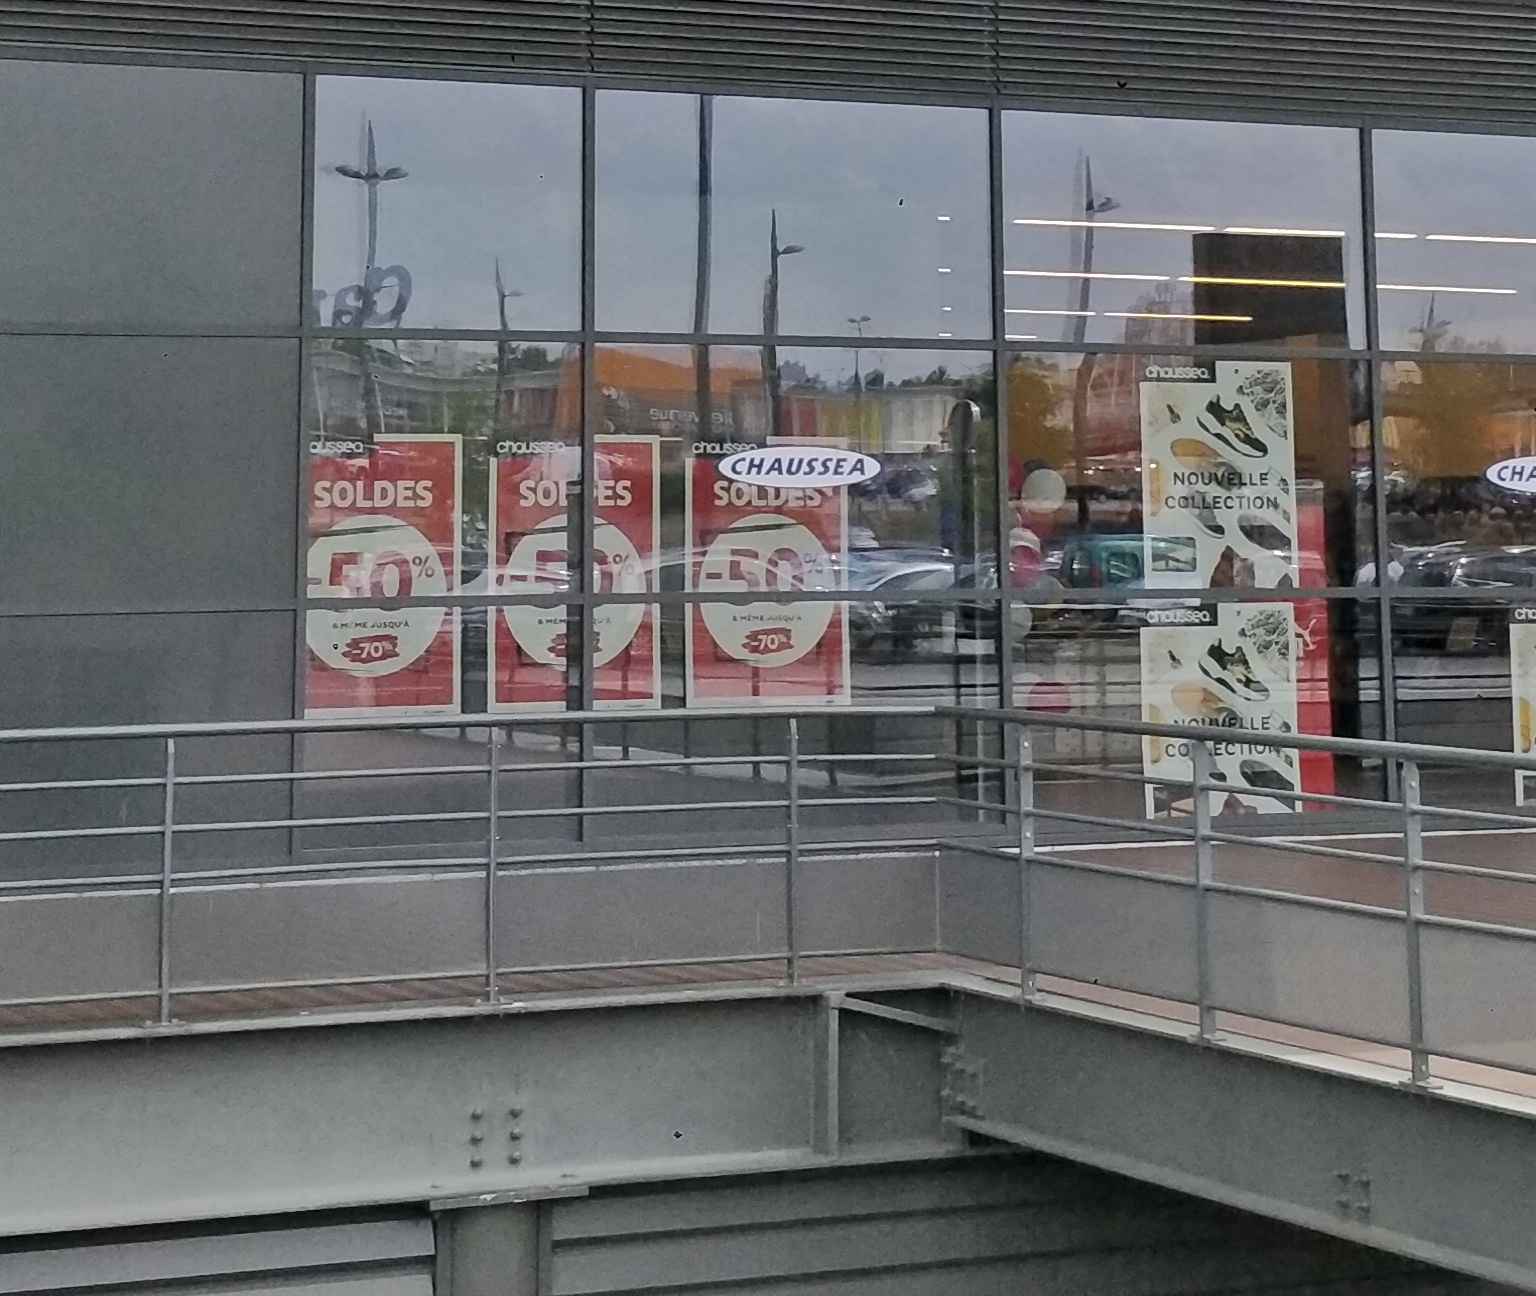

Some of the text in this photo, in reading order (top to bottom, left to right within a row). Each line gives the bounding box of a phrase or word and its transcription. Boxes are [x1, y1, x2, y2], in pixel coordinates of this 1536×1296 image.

[309, 441, 364, 454] aussea
[730, 457, 867, 476] CHAUSSEA
[1173, 471, 1269, 487] NOUVELLE
[314, 480, 434, 508] SOLDES
[519, 480, 633, 508] SOES
[1164, 495, 1280, 510] COLLECTION
[340, 621, 368, 629] MME
[1164, 741, 1281, 757] COECTION
